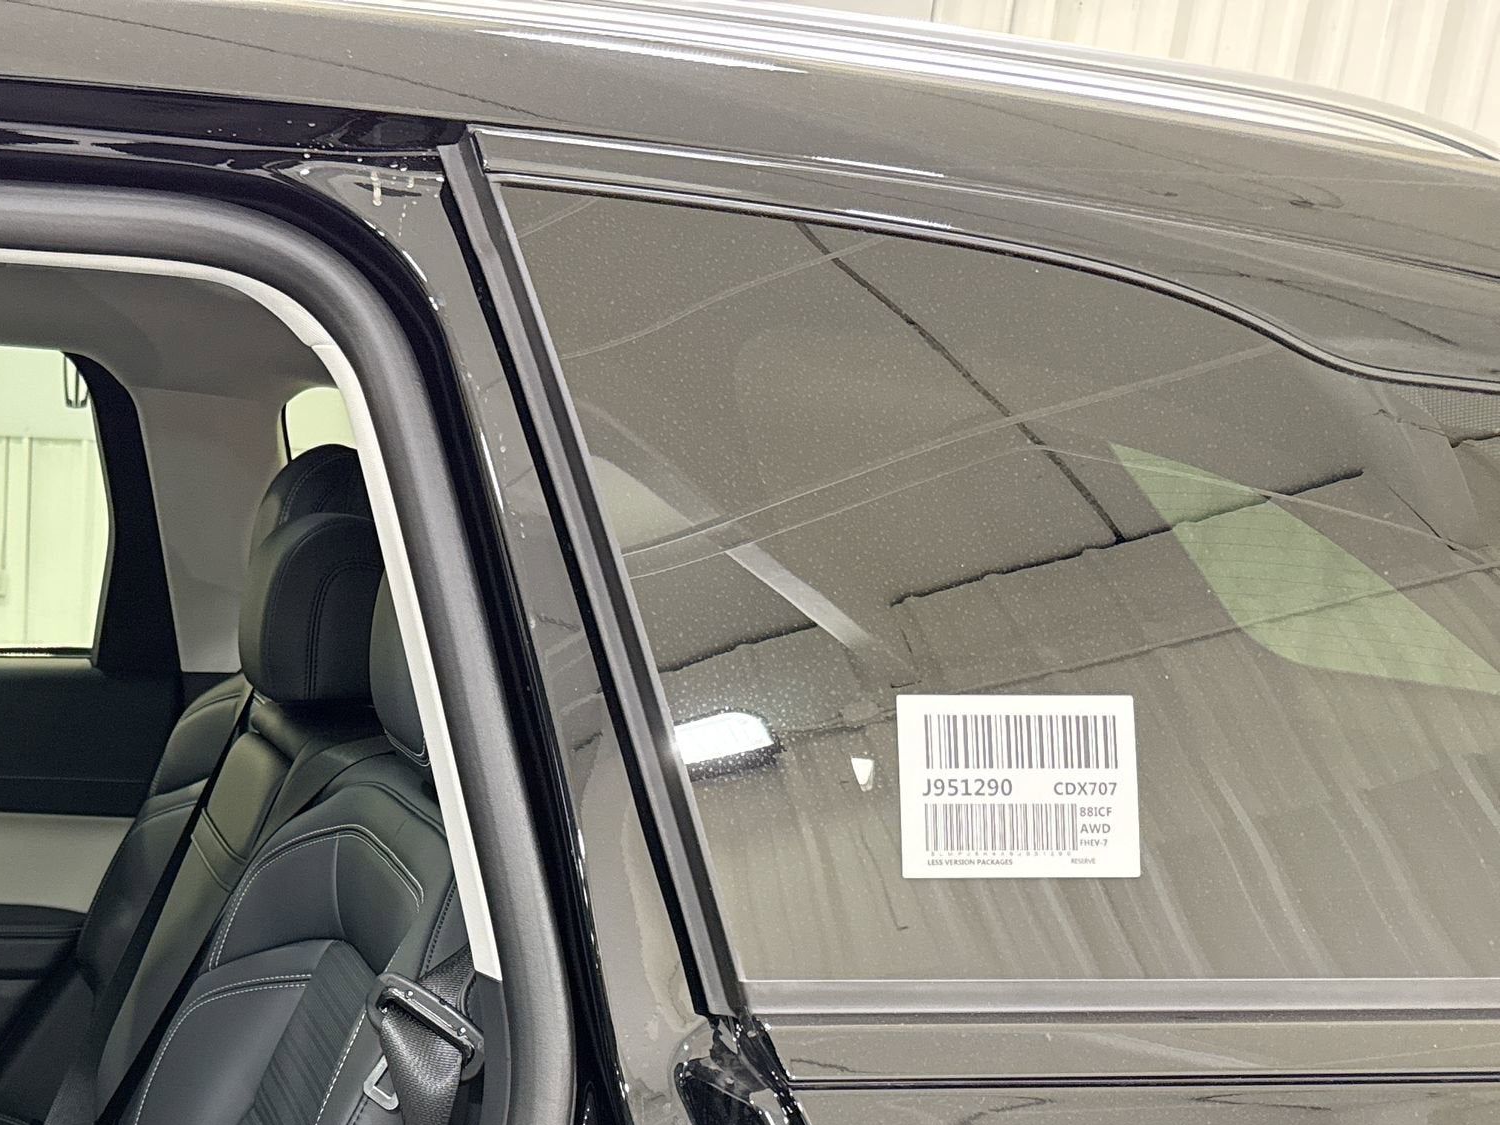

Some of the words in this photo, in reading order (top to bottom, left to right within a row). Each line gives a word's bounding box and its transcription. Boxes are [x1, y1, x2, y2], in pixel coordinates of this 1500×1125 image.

[922, 778, 1013, 797] J951290
[1053, 782, 1118, 796] CDX707
[1079, 807, 1113, 818] 88ICF
[1080, 823, 1111, 834] AWD
